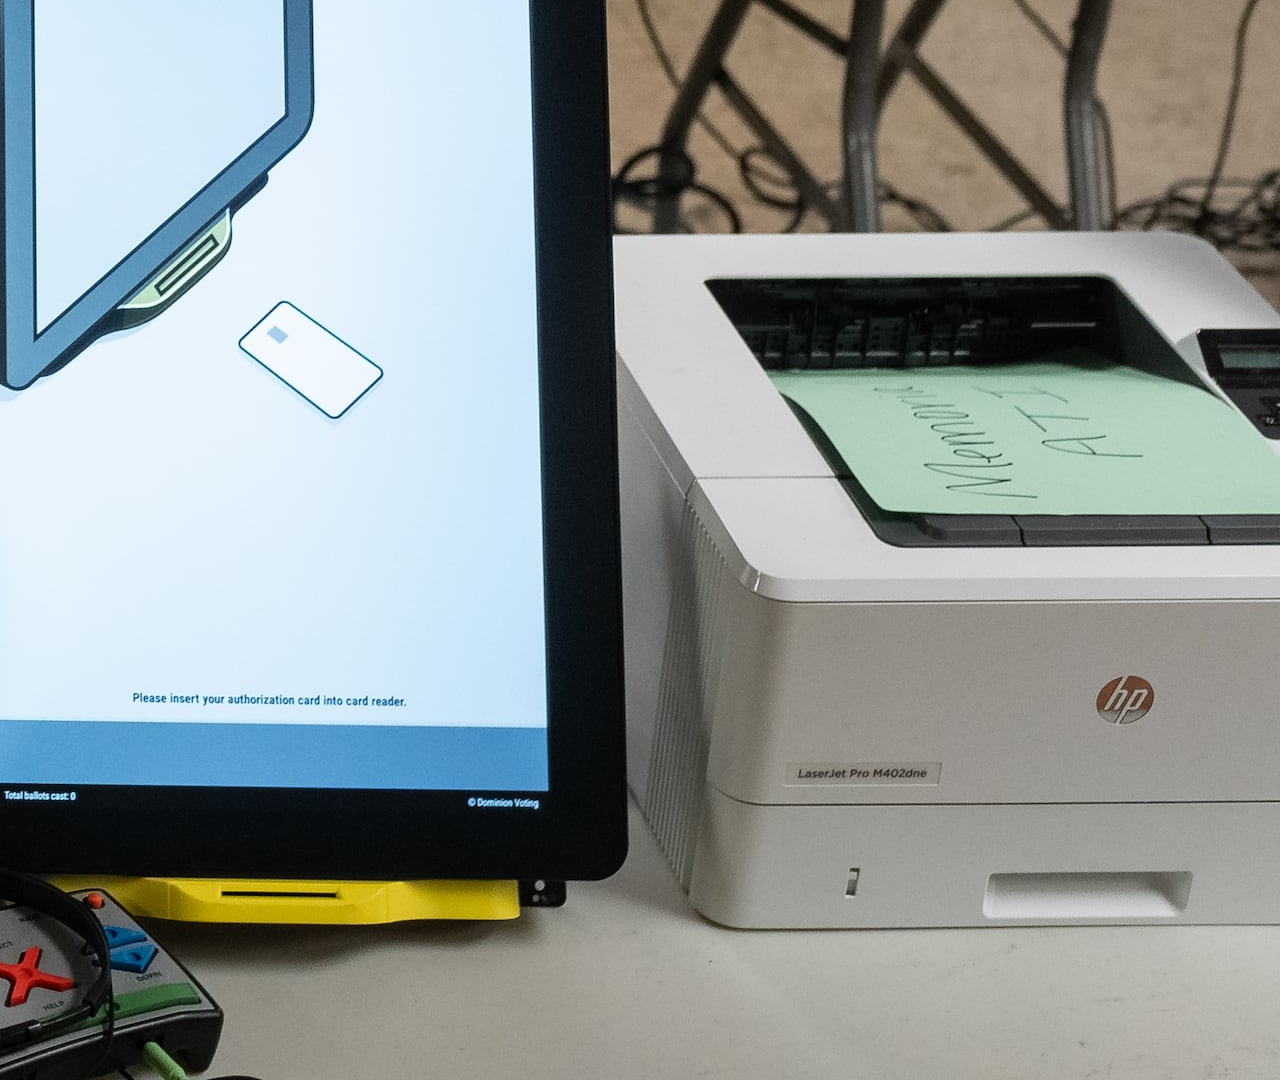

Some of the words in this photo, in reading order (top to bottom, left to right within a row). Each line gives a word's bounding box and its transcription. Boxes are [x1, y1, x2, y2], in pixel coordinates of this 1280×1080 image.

[132, 692, 167, 703] Please
[170, 693, 199, 704] insert
[203, 695, 224, 706] your
[227, 694, 295, 705] authorization
[298, 694, 320, 706] card
[323, 695, 343, 706] into
[345, 695, 368, 706] card
[371, 696, 407, 707] reader.
[1101, 675, 1151, 724] hp
[797, 768, 845, 779] LaserJet
[849, 768, 869, 779] Pro
[872, 768, 927, 779] M402dne
[3, 791, 23, 800] Total
[23, 791, 50, 800] ballots
[50, 792, 70, 801] cast:
[70, 791, 76, 801] 0
[477, 797, 513, 808] Dominion
[513, 798, 540, 810] Voting
